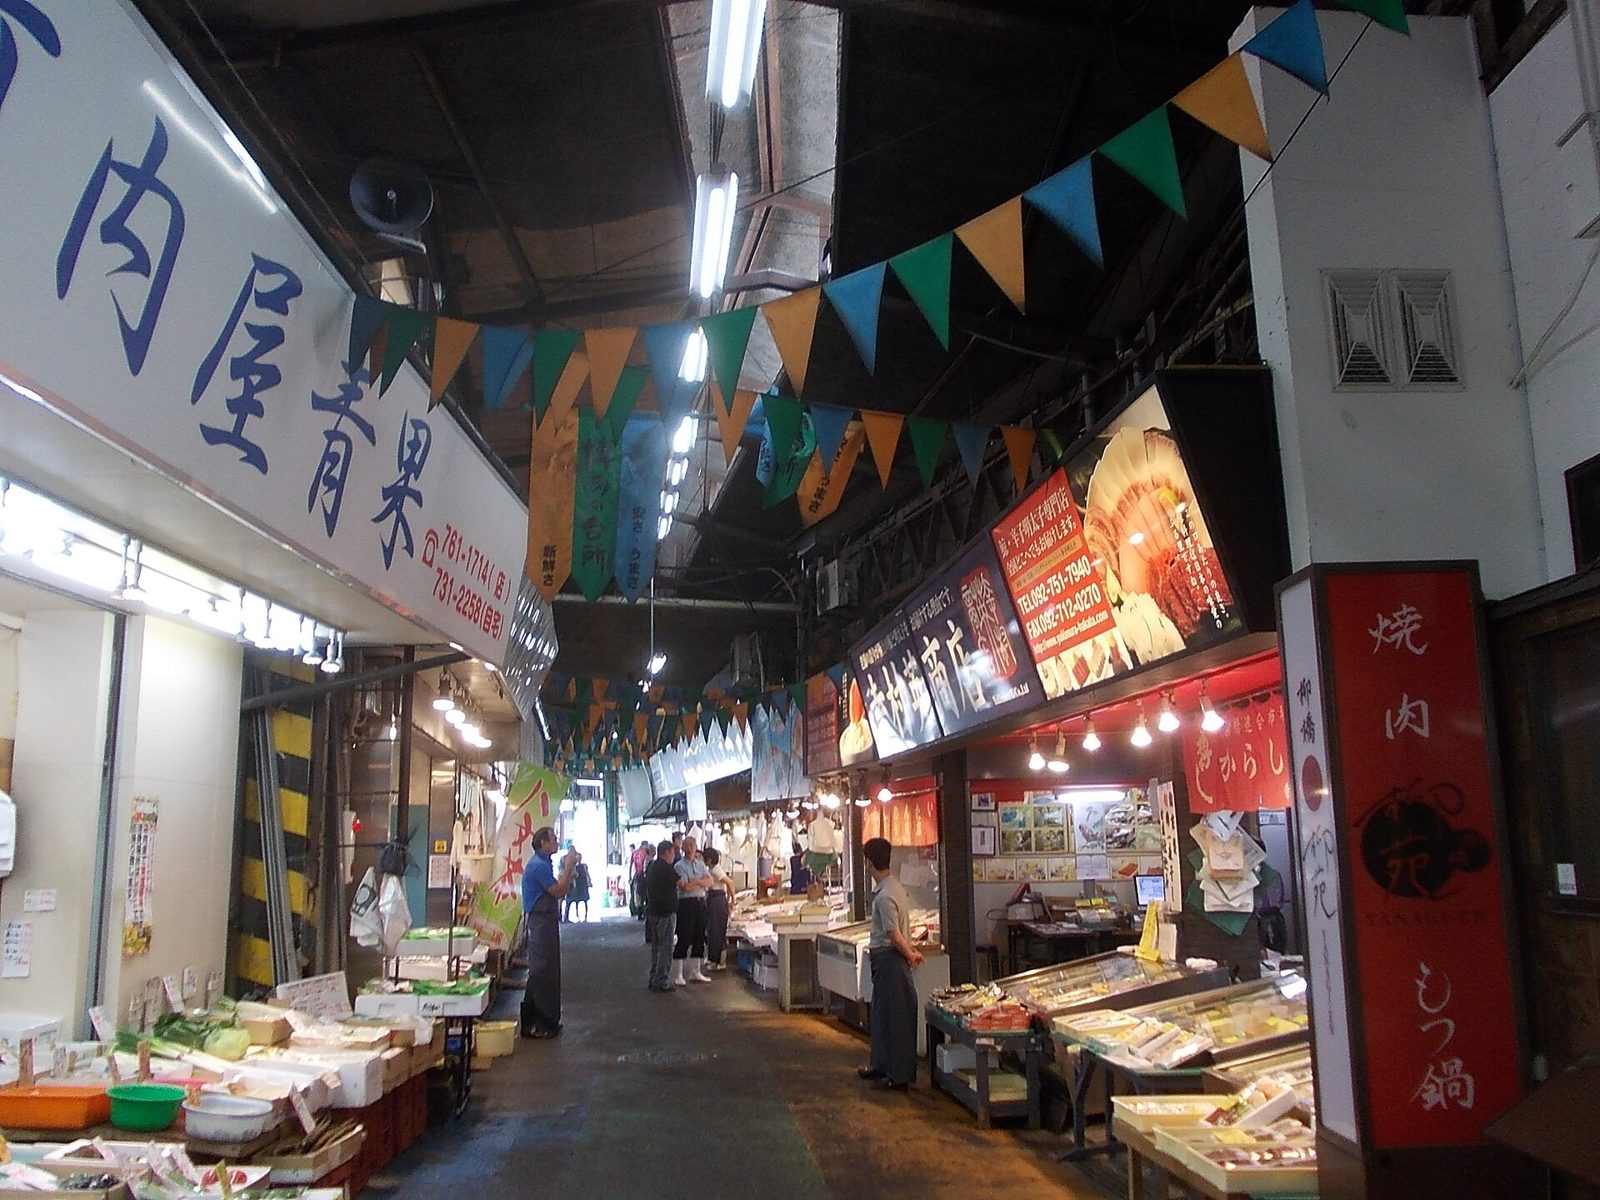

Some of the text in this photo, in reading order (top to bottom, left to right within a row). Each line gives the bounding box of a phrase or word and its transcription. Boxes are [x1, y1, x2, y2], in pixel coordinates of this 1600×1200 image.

[1368, 603, 1431, 740] 焼肉
[1412, 961, 1476, 1111] もつ鍋
